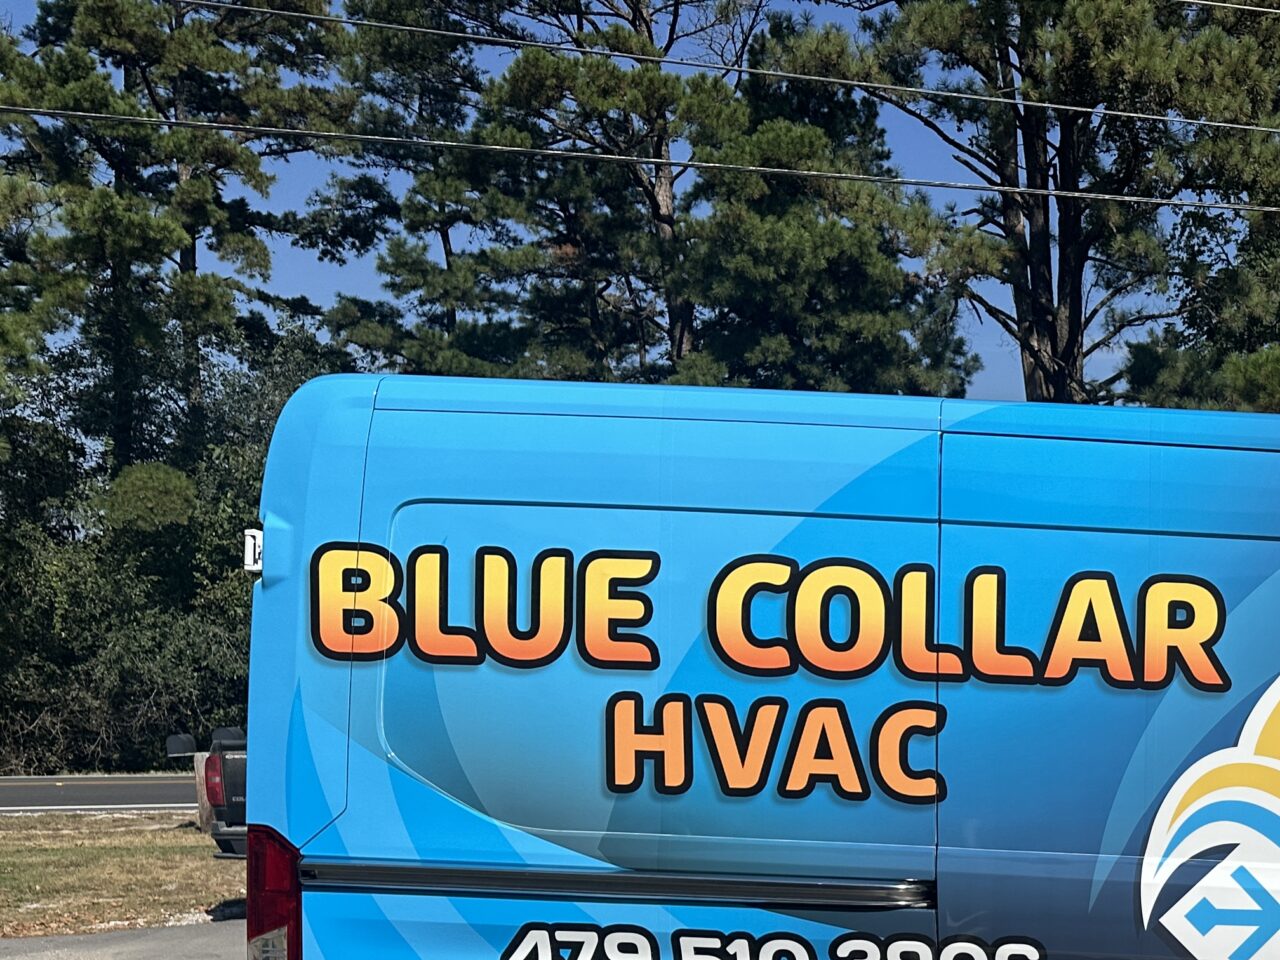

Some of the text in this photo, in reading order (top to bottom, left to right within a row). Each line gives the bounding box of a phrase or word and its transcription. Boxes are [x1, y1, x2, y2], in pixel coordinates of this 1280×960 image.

[314, 547, 1229, 688] BLUE COLLAR
[608, 695, 944, 799] HVAC
